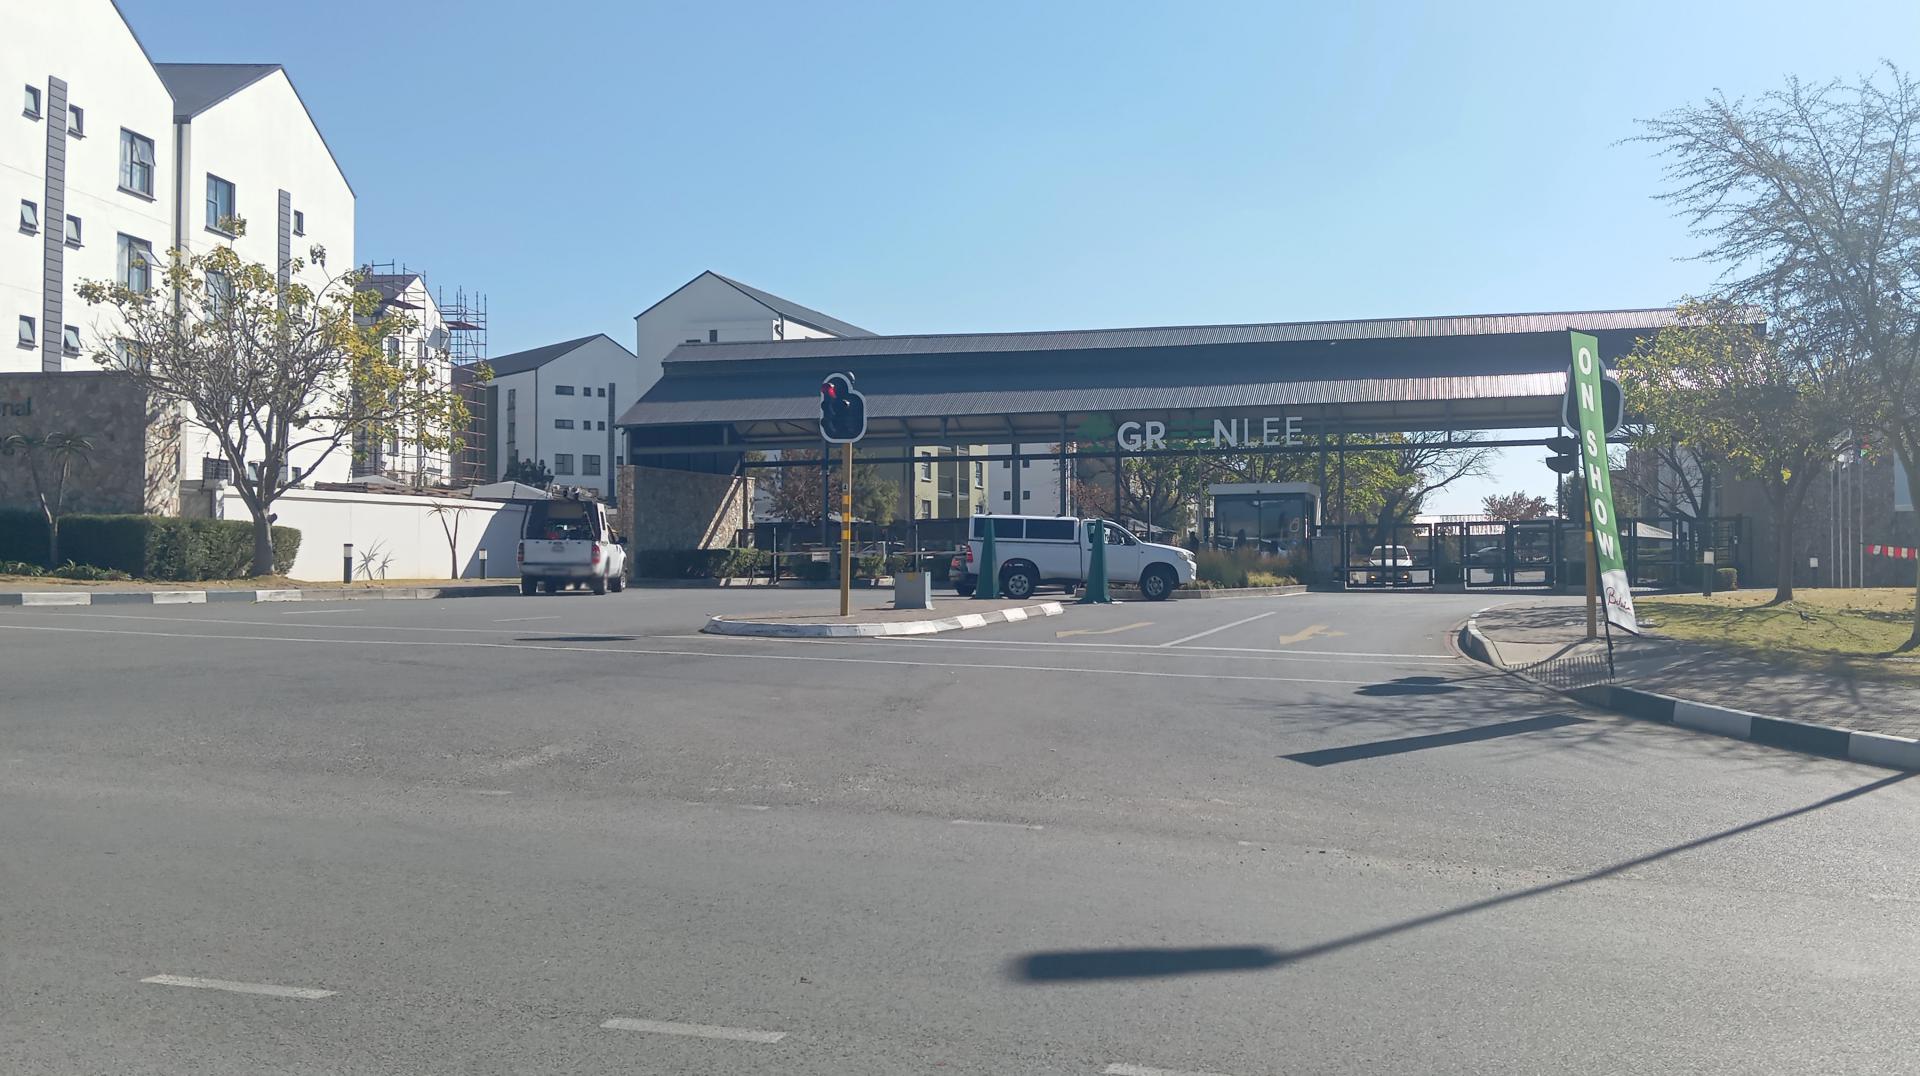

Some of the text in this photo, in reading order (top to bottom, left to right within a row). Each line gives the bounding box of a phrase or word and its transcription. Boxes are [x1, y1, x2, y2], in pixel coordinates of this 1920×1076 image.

[0, 397, 31, 417] nal
[1578, 347, 1615, 561] ON SHOW
